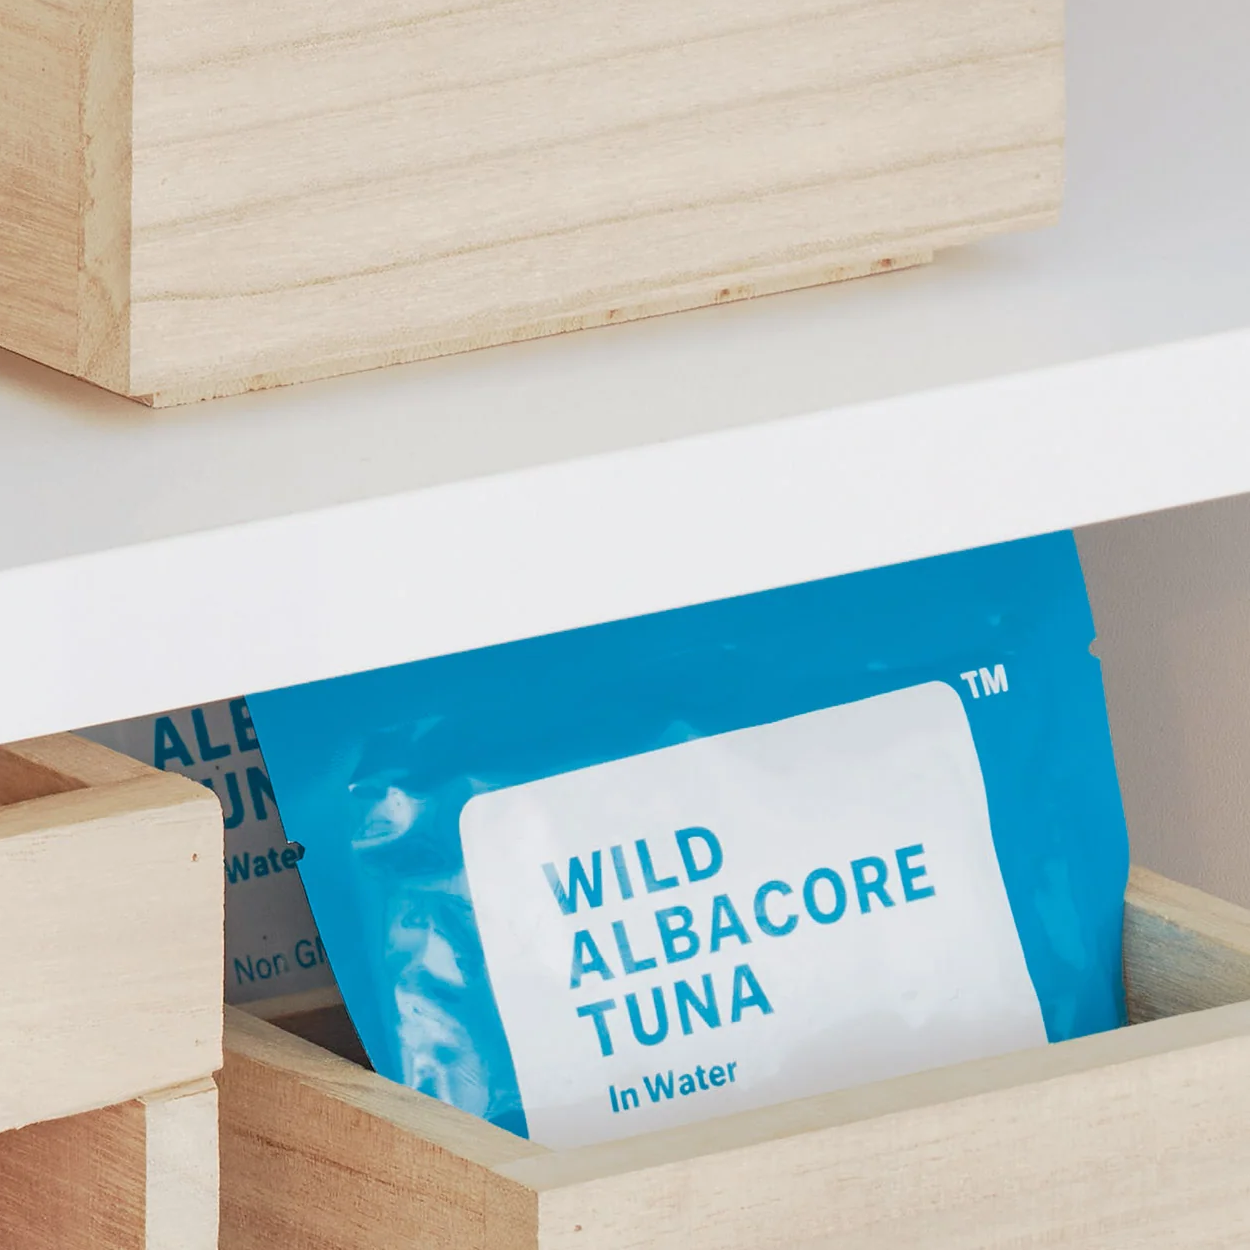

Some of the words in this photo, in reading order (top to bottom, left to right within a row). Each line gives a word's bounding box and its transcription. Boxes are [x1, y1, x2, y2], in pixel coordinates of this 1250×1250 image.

[960, 663, 1009, 700] TM
[541, 825, 724, 916] WILD
[569, 842, 936, 990] ALBACORE
[233, 950, 290, 986] Non
[575, 963, 775, 1058] TUNA
[608, 1083, 640, 1113] In
[643, 1059, 738, 1103] Water
